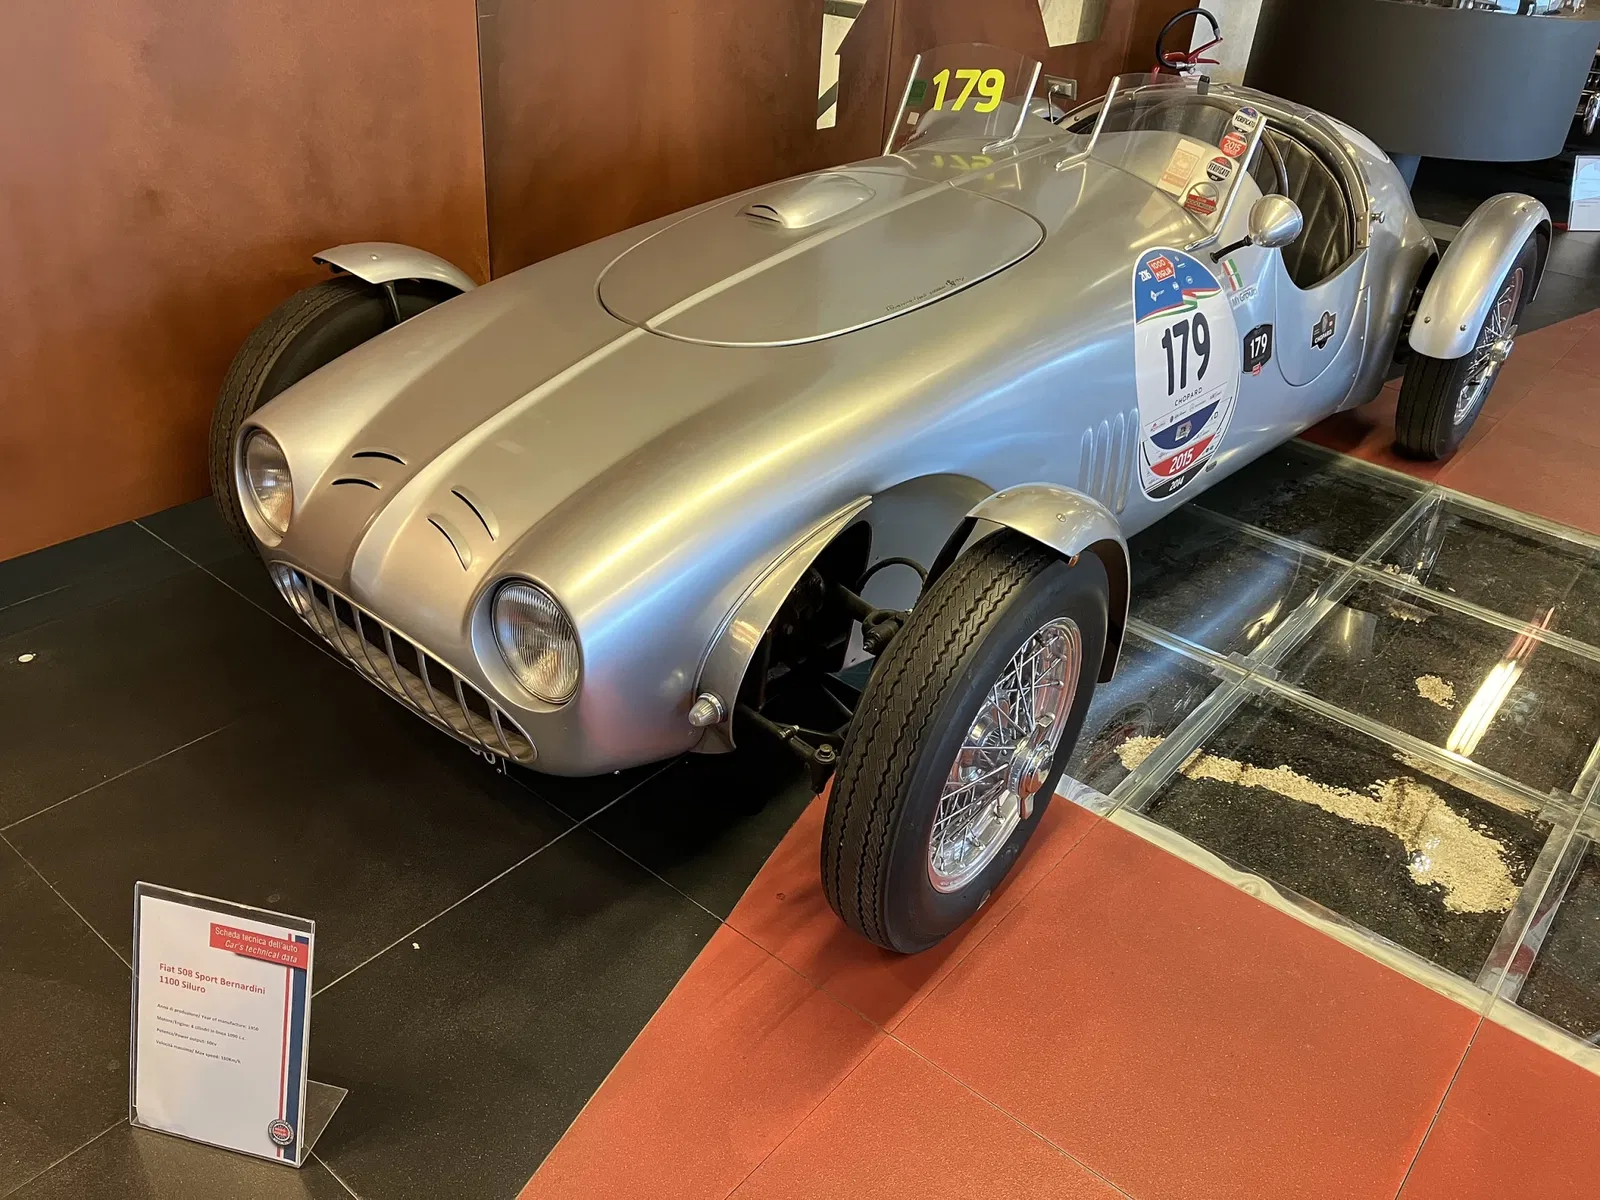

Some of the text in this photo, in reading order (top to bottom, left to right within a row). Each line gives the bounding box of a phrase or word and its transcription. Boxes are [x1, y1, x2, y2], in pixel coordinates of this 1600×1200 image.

[932, 68, 1006, 113] 179
[1224, 140, 1241, 151] 2015
[1150, 259, 1166, 269] 1000
[1156, 267, 1173, 279] MIGLIA
[1161, 312, 1211, 397] 179
[1250, 333, 1268, 359] 179
[1174, 387, 1203, 406] CHOPARD
[1168, 447, 1195, 475] 2015
[215, 927, 298, 953] Scheda tecnica dell'auto
[224, 940, 298, 964] Car's technical data
[159, 963, 266, 995] Fiat 508 Sport Bernardini
[159, 975, 206, 993] 1100 Siluro
